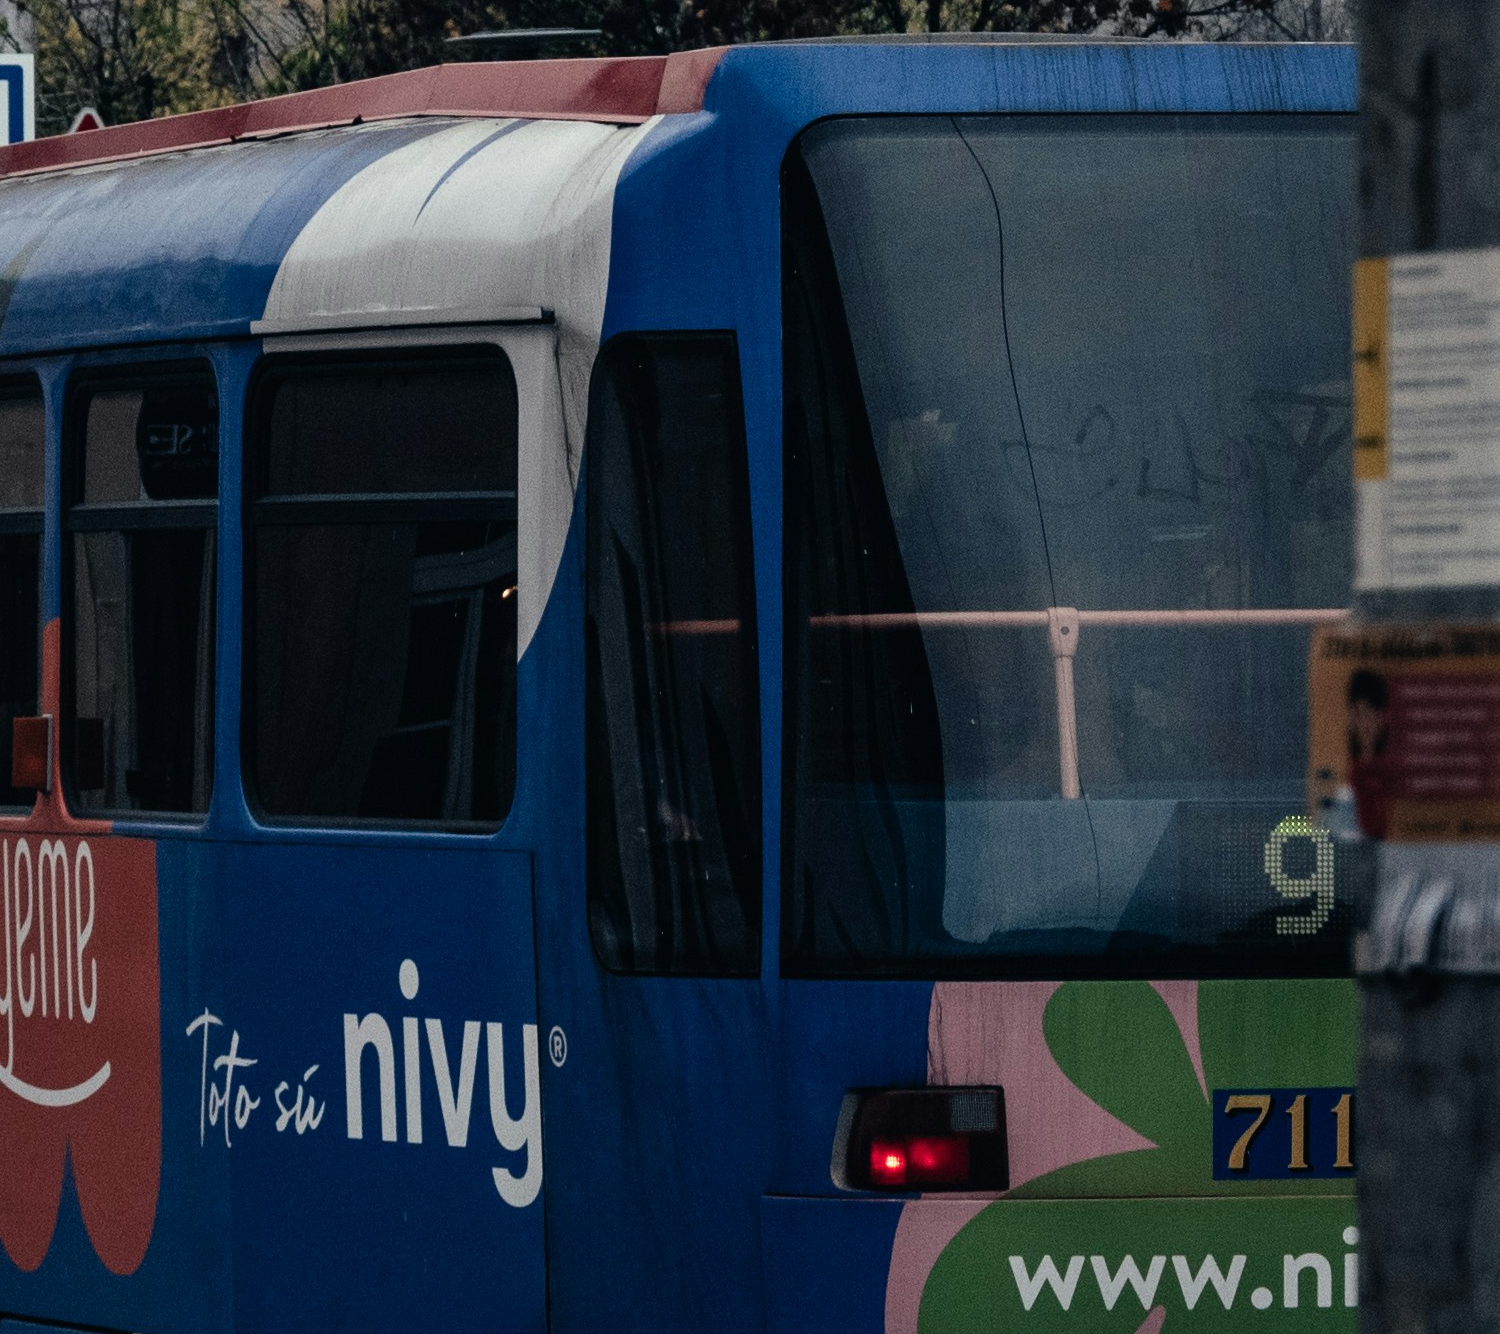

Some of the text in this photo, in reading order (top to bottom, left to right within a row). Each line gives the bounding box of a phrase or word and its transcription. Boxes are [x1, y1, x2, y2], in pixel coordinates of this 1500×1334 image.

[1264, 815, 1335, 937] 9
[186, 1006, 262, 1149] Toto
[274, 1063, 327, 1136] sú
